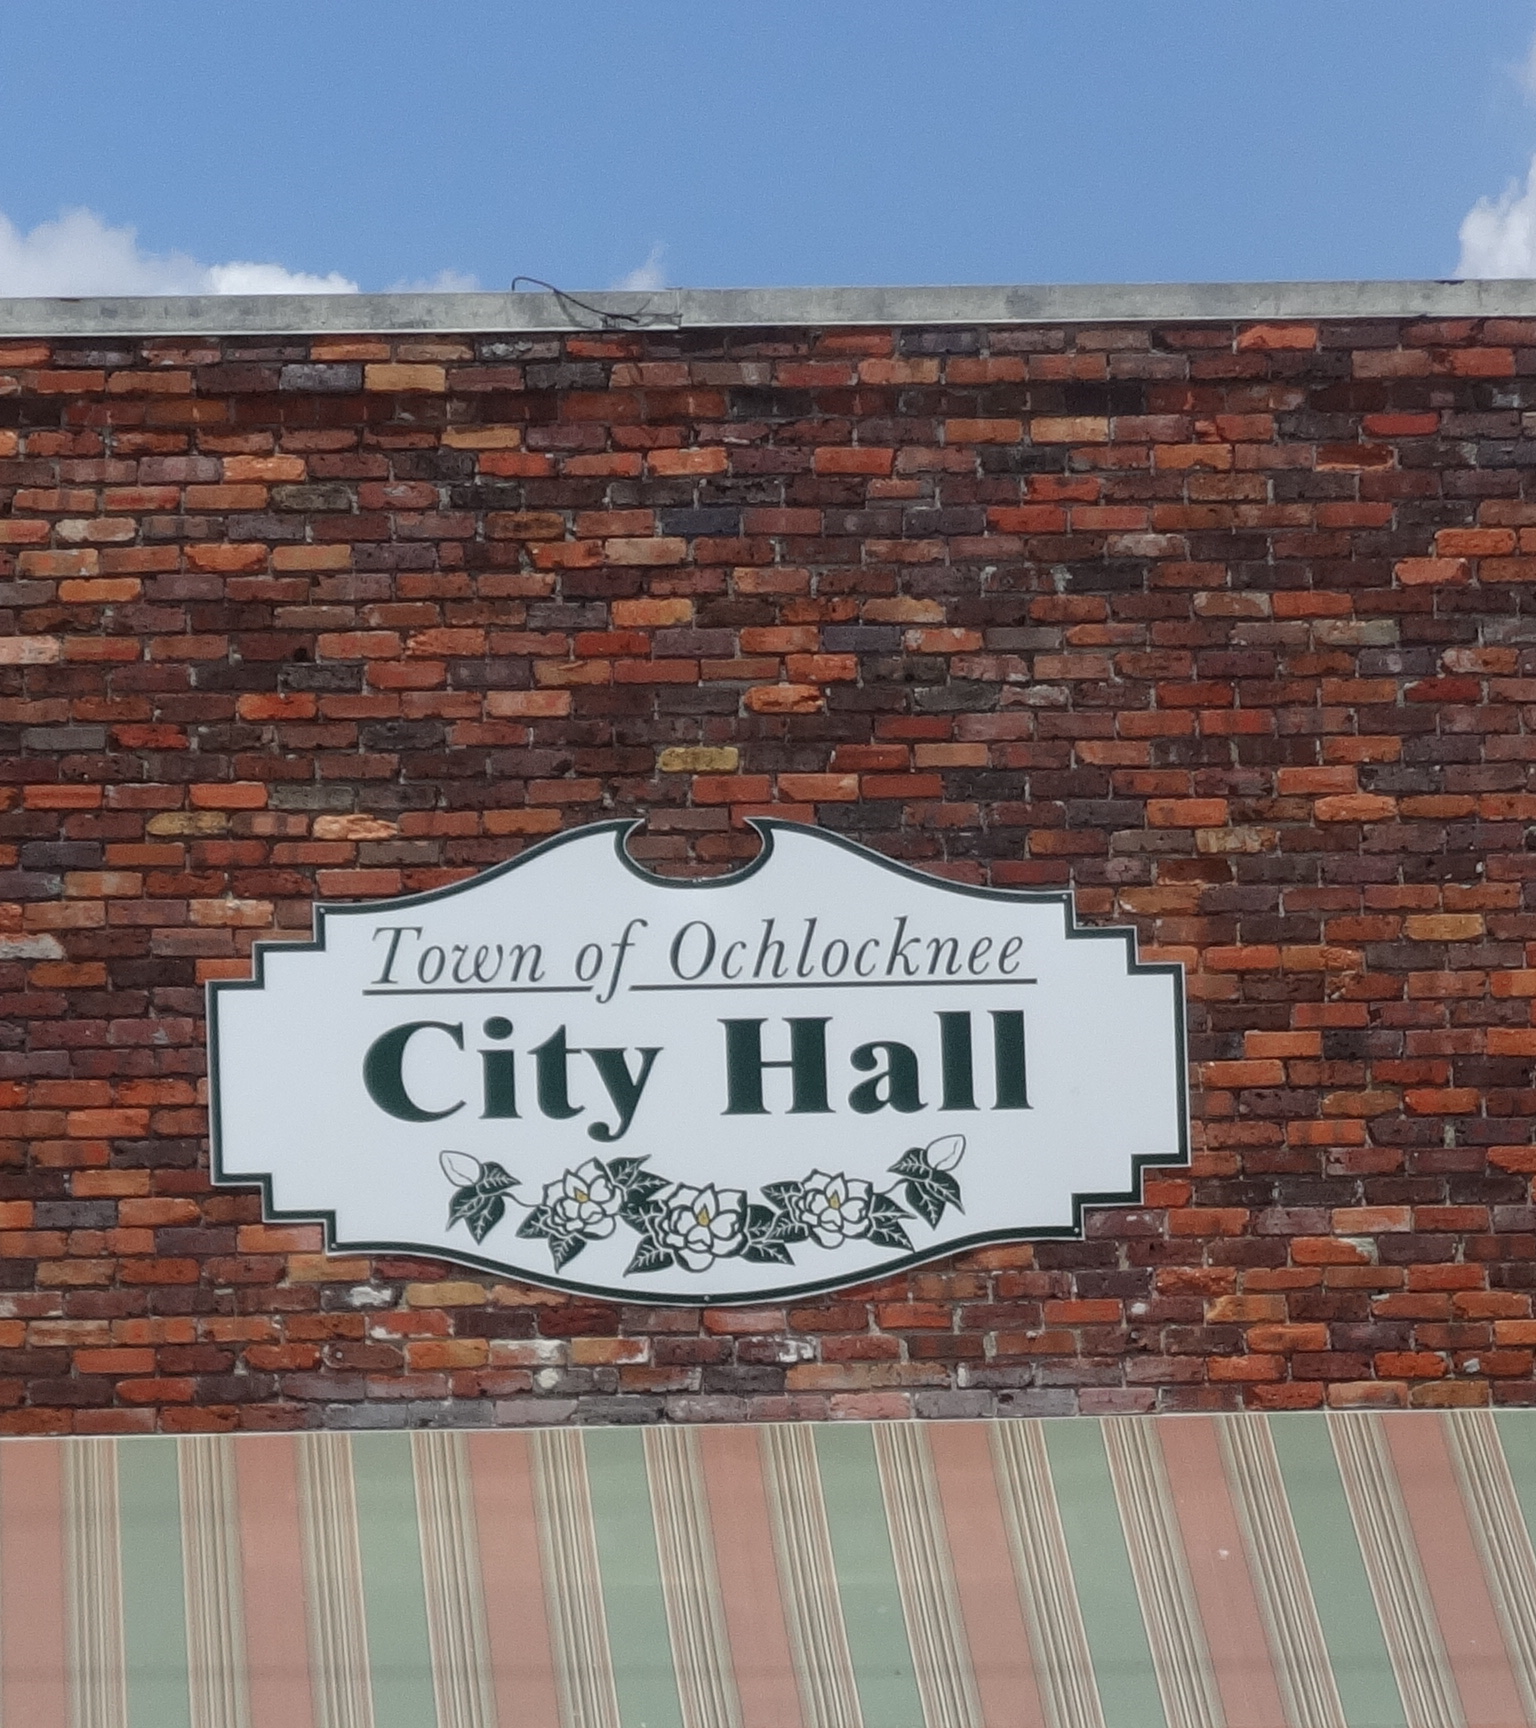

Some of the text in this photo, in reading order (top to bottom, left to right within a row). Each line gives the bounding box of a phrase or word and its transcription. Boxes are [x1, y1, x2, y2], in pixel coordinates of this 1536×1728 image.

[370, 914, 1025, 1004] Town of Ochlocknee
[362, 1008, 1035, 1142] City Hall
